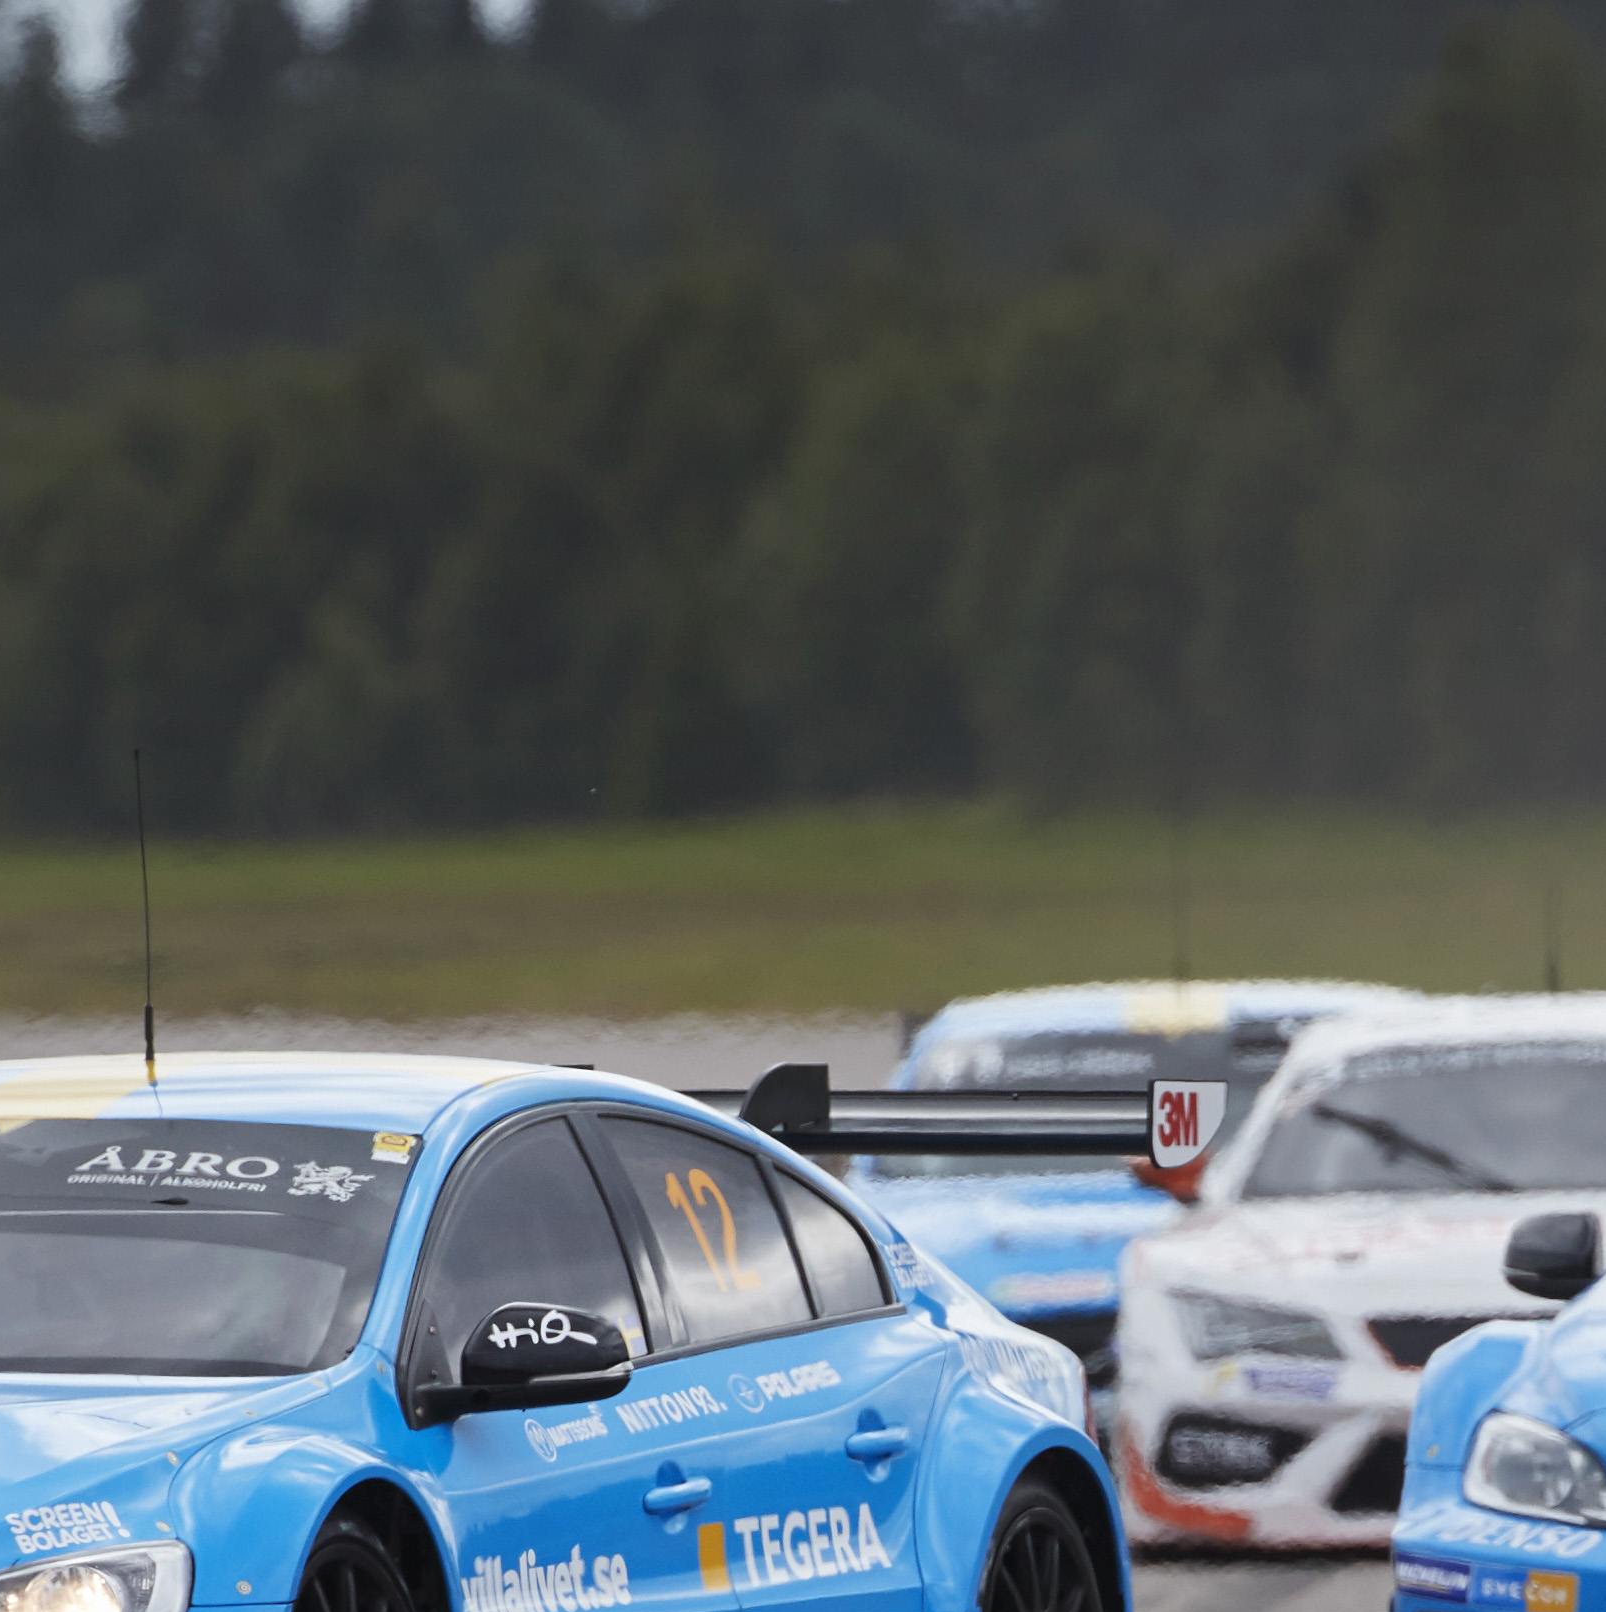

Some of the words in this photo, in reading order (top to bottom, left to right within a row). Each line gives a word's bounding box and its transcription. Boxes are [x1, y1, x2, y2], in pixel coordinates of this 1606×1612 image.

[1158, 1090, 1199, 1147] 3M
[67, 1173, 144, 1186] ORIGINAL
[75, 1146, 280, 1180] ÅBRO
[665, 1168, 762, 1293] 12
[488, 1310, 598, 1348] HiQ
[755, 1360, 842, 1401] POLARIS
[735, 1503, 892, 1588] TEGERA
[1437, 1518, 1603, 1559] DENSO
